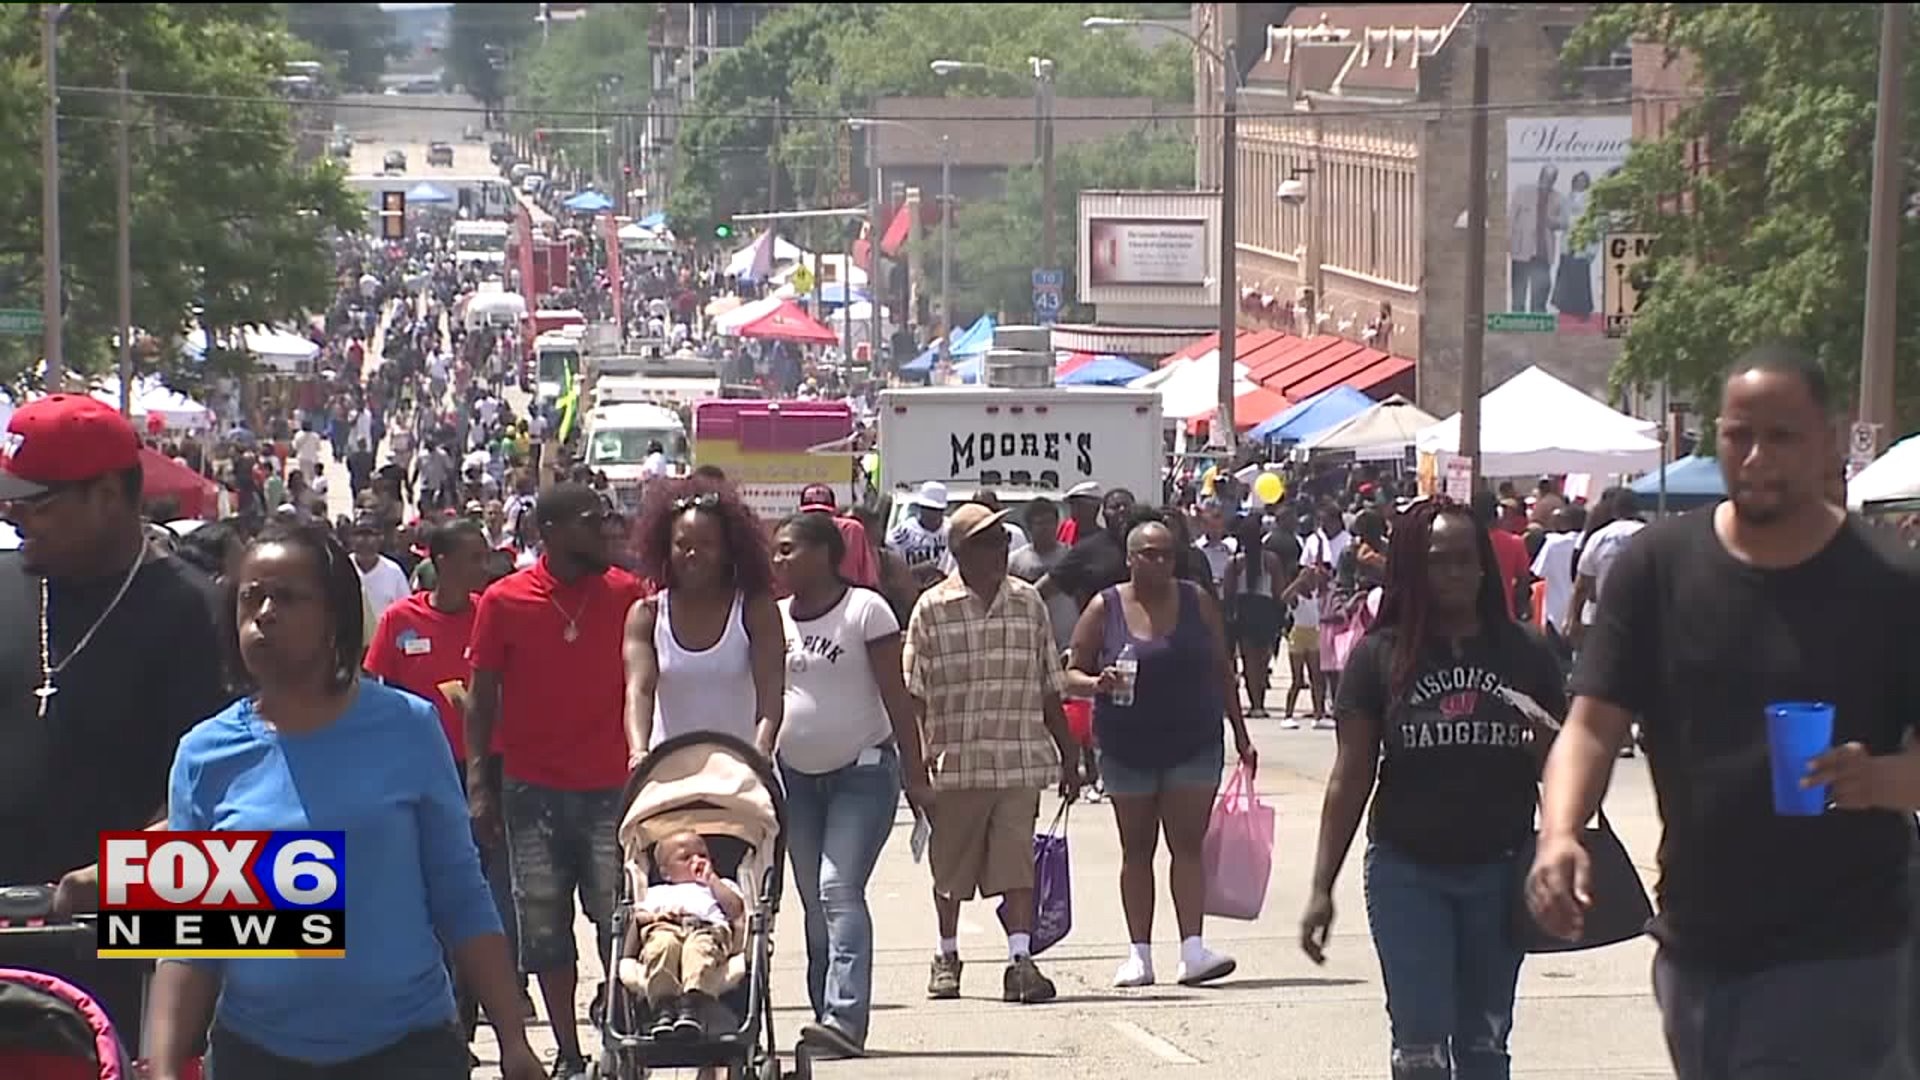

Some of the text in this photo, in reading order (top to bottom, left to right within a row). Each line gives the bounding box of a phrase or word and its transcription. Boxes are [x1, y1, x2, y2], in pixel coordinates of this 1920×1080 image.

[1036, 293, 1058, 309] 43
[951, 432, 1092, 476] MOORE'S
[802, 635, 844, 664] PINK
[1402, 721, 1521, 748] BADGERS
